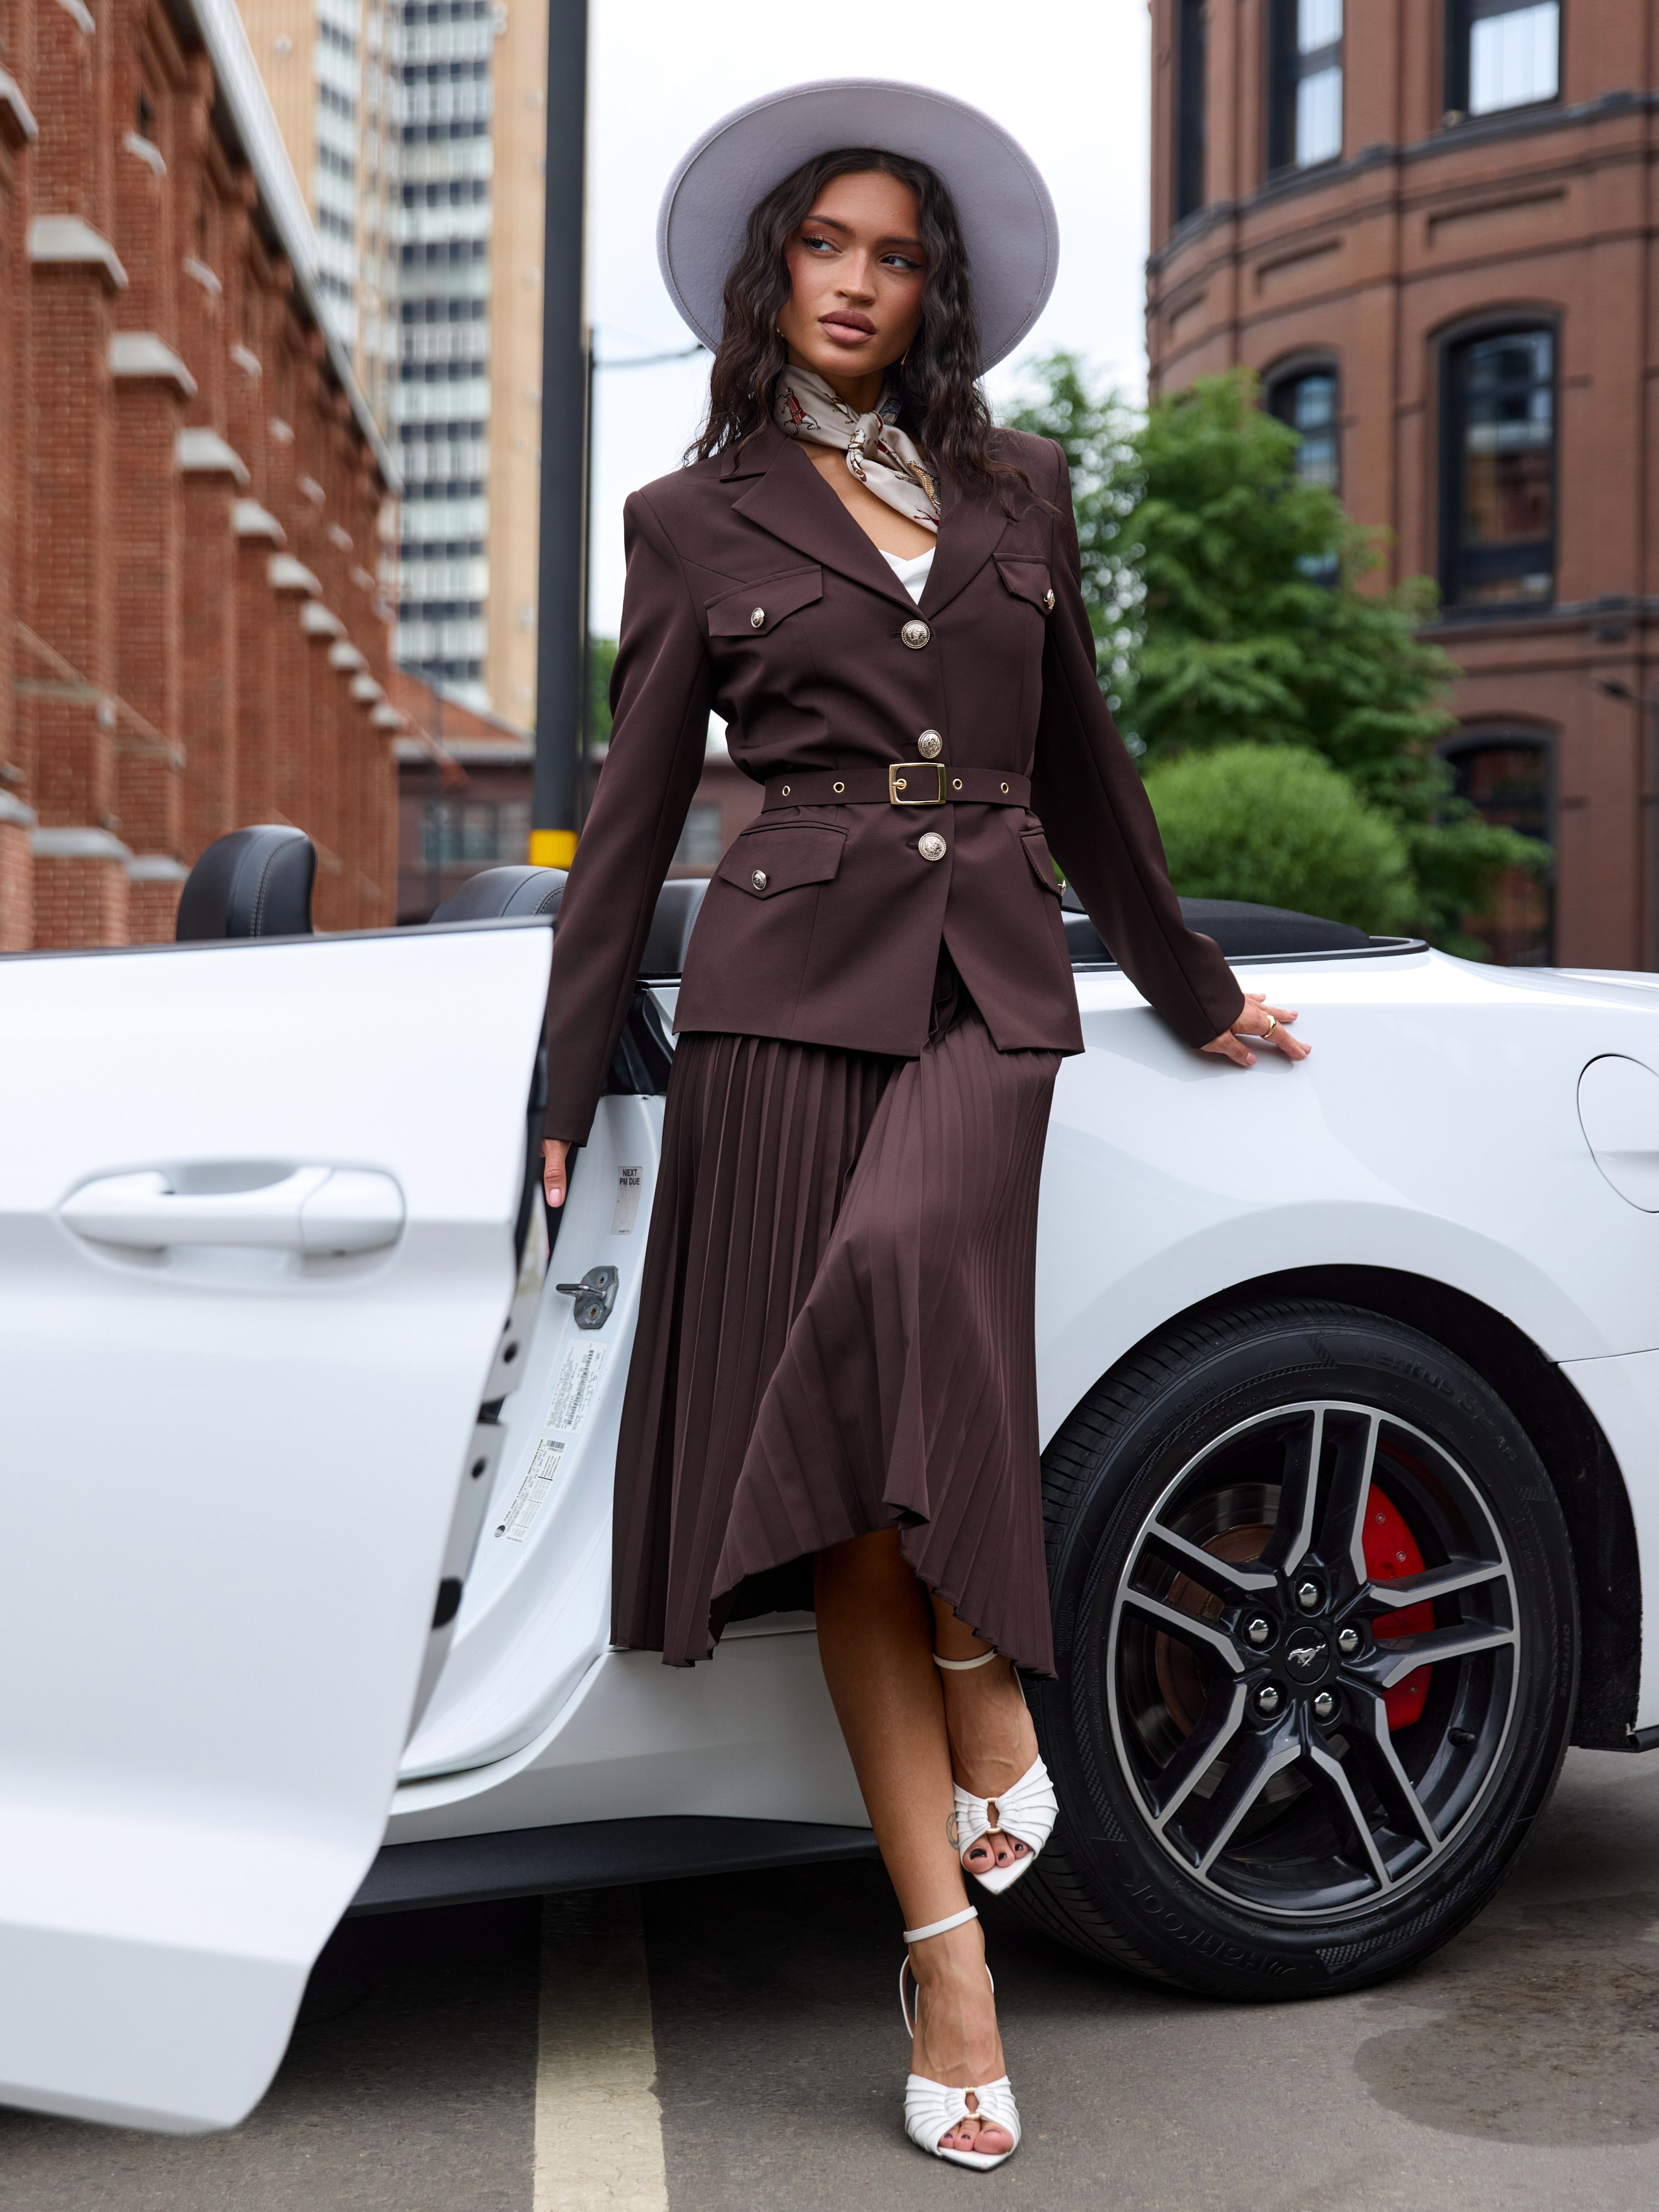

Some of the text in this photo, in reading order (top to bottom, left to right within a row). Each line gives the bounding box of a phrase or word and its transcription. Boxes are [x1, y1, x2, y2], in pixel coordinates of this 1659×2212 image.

[517, 1476, 528, 1498] LOADING
[528, 1439, 544, 1474] INFORMATION
[1559, 1623, 1571, 1699] OUTSIDE
